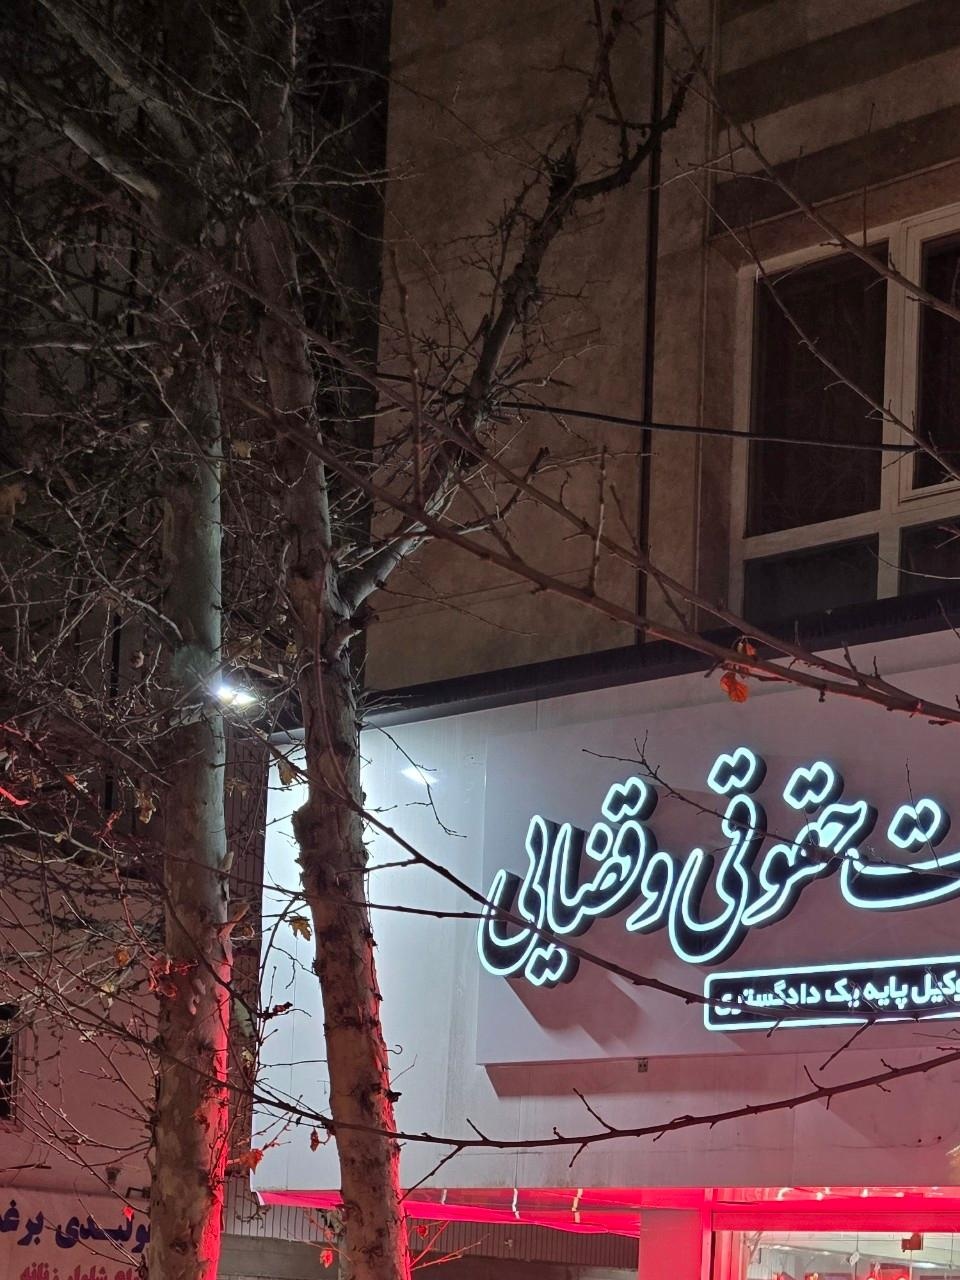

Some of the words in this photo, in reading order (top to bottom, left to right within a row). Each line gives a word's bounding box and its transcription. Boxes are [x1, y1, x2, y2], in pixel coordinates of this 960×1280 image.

[668, 746, 869, 964] حقوقی
[477, 776, 650, 988] قضایی
[626, 851, 675, 932] و
[714, 979, 820, 1017] دادگستری
[824, 977, 860, 1009] یک
[863, 975, 908, 1010] پایه
[0, 1199, 44, 1246] برغ
[54, 1209, 150, 1254] ولیدی
